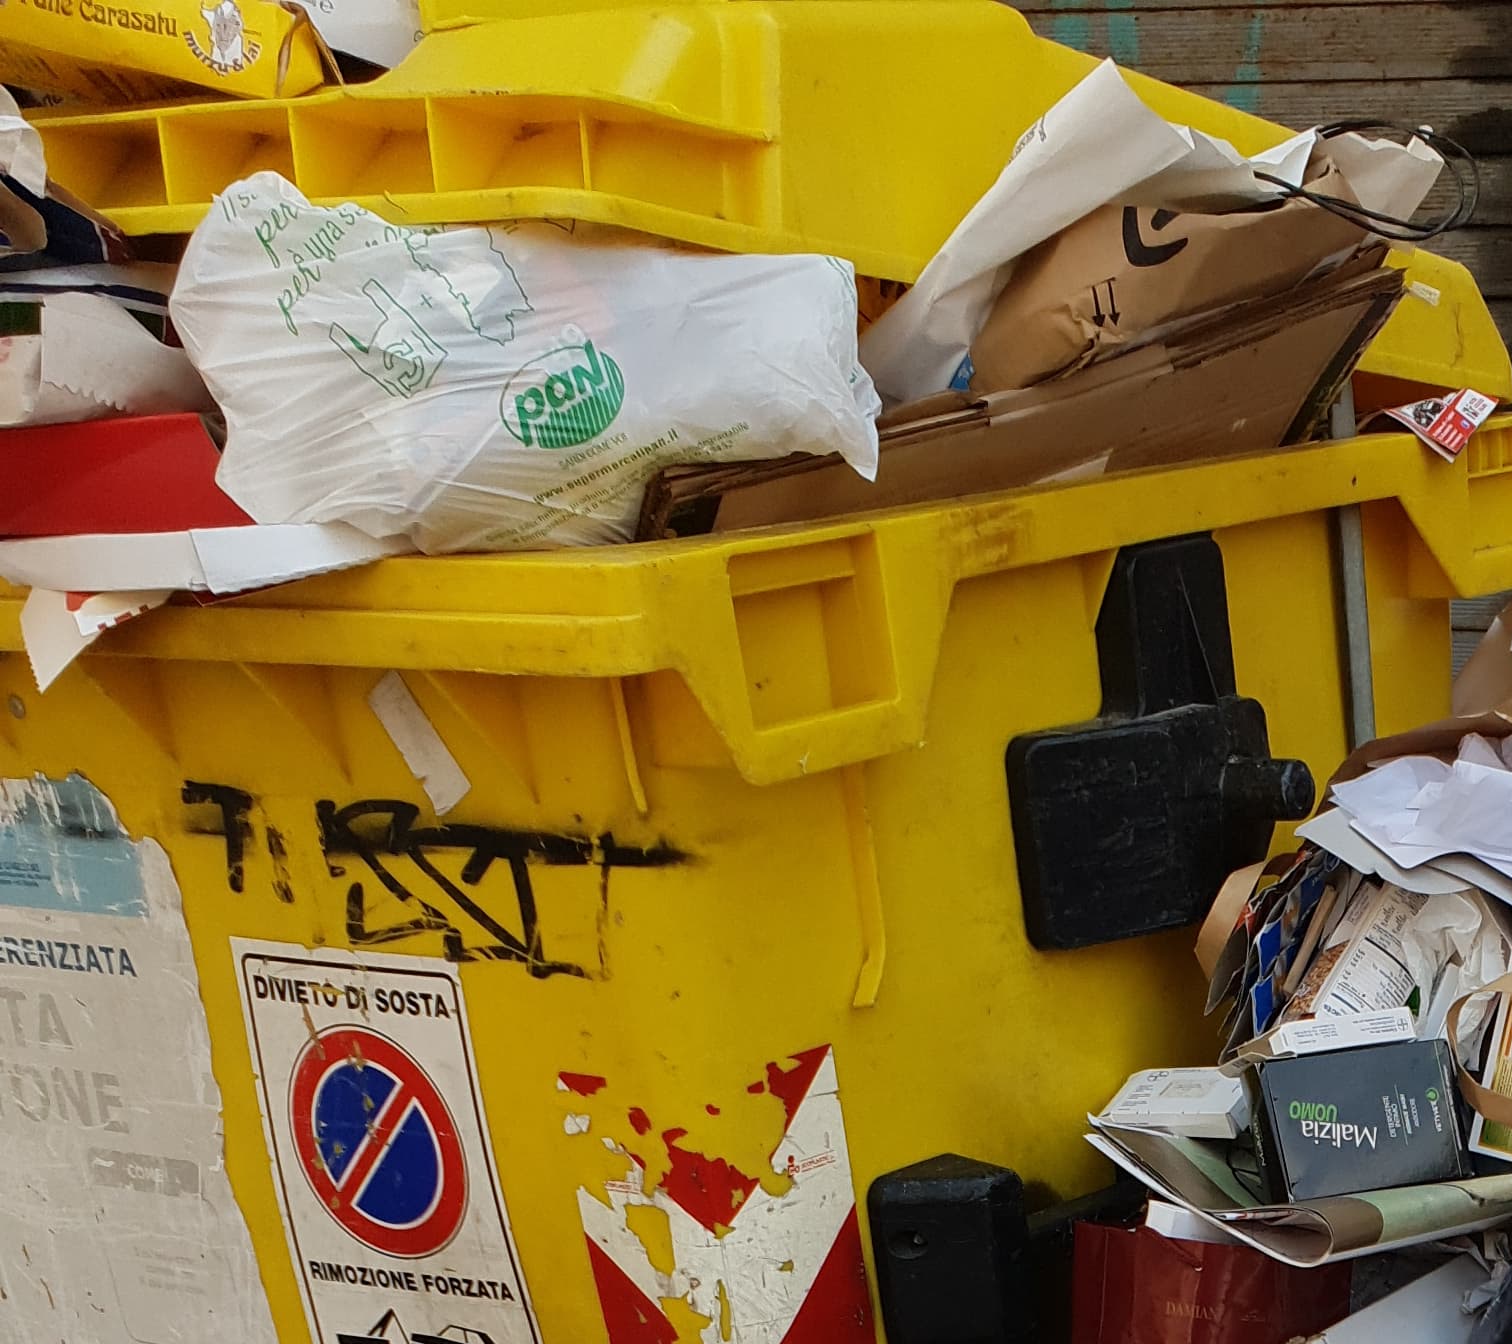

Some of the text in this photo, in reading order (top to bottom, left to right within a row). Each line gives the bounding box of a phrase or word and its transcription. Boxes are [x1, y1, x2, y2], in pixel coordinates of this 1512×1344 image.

[253, 975, 450, 1018] DIVIETO SOSTA
[1289, 1101, 1337, 1122] UOMO
[1301, 1120, 1377, 1149] Malizia
[309, 1261, 514, 1302] RIMOZIONE FORZATA
